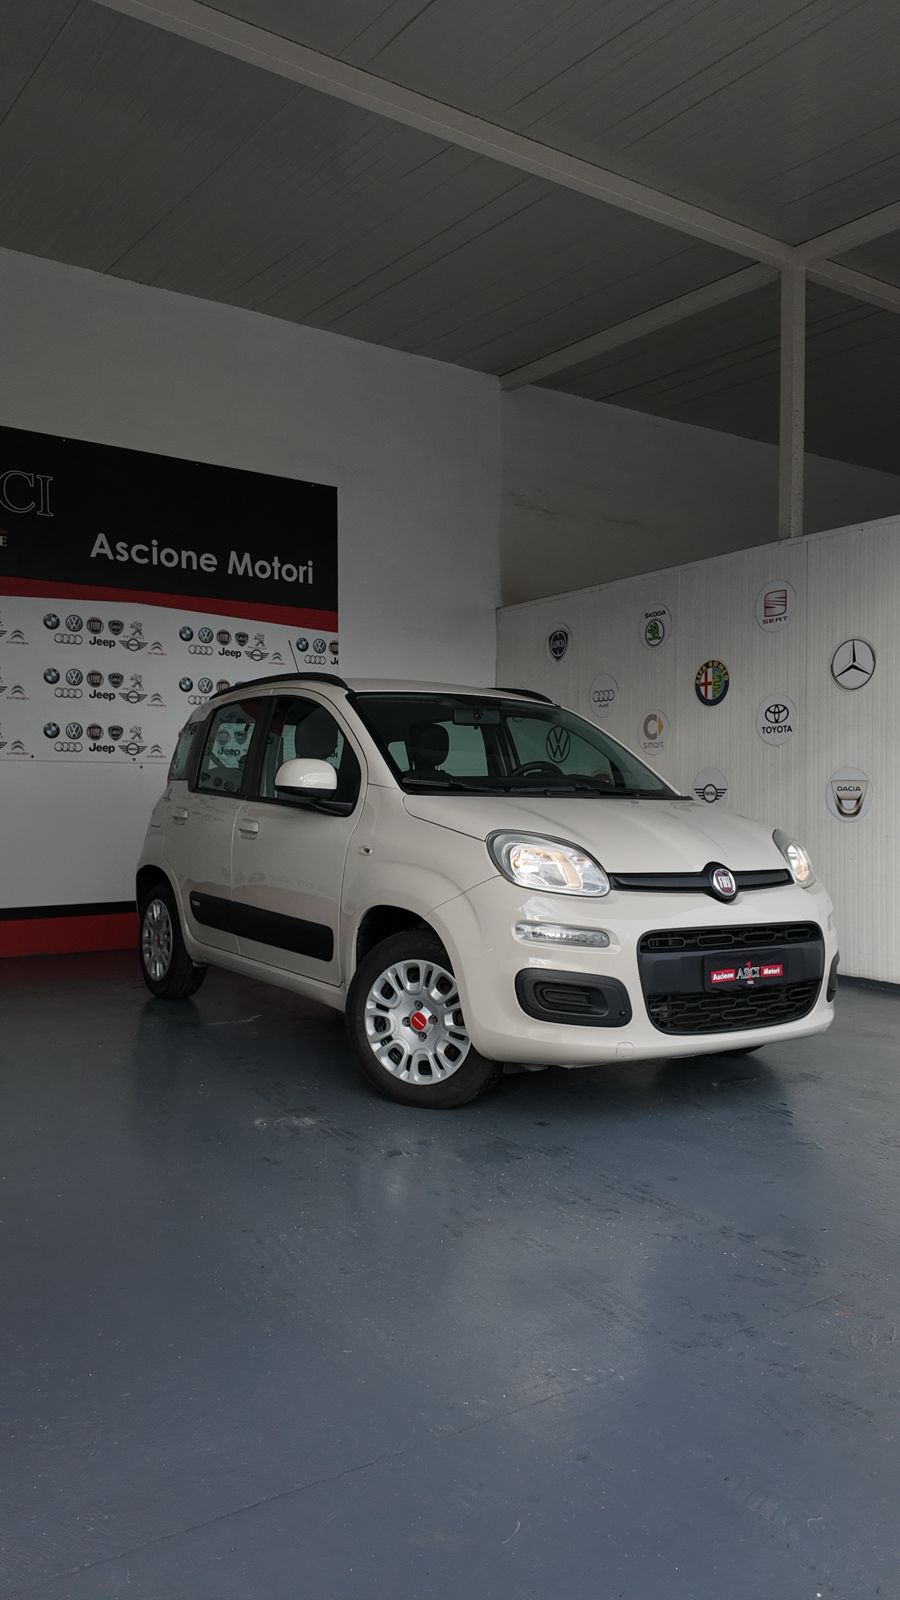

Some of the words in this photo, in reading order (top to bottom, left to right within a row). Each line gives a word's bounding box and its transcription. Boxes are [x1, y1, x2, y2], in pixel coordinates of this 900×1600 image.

[90, 533, 218, 572] Ascione
[228, 551, 313, 584] Motori
[762, 615, 788, 625] SEAT
[89, 636, 116, 648] Jeep
[218, 647, 242, 659] Jeep
[89, 689, 116, 701] Jeep
[761, 725, 793, 734] TOYOTA
[89, 742, 116, 754] Jeep
[643, 740, 664, 749] smart
[217, 747, 241, 757] Jeep
[836, 785, 861, 793] DACIA
[712, 972, 734, 981] Ascione
[763, 966, 780, 975] Motori
